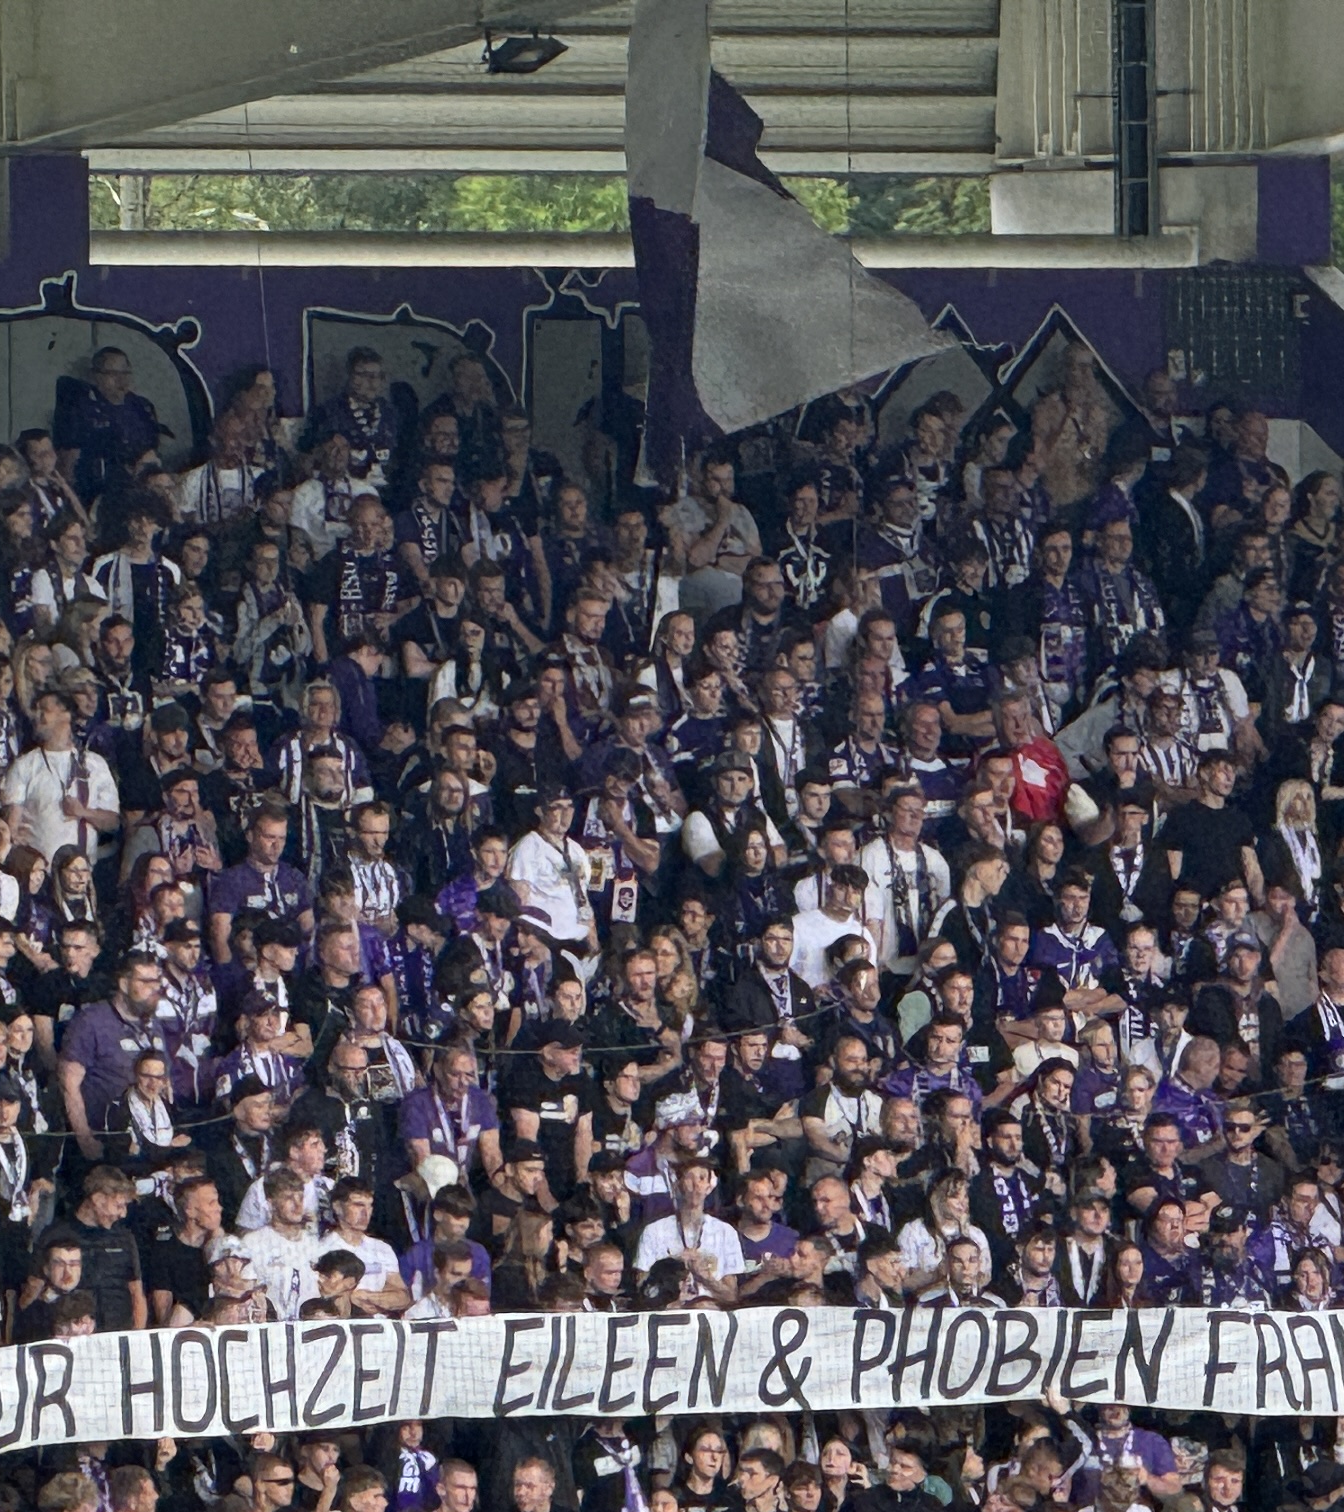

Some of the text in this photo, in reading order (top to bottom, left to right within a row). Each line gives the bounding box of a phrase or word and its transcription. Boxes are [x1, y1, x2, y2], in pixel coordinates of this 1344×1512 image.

[120, 1319, 457, 1437] HOCHZEIT
[494, 1311, 738, 1417] EILEEN
[757, 1308, 813, 1411] &
[853, 1306, 1174, 1404] PHOBIEN
